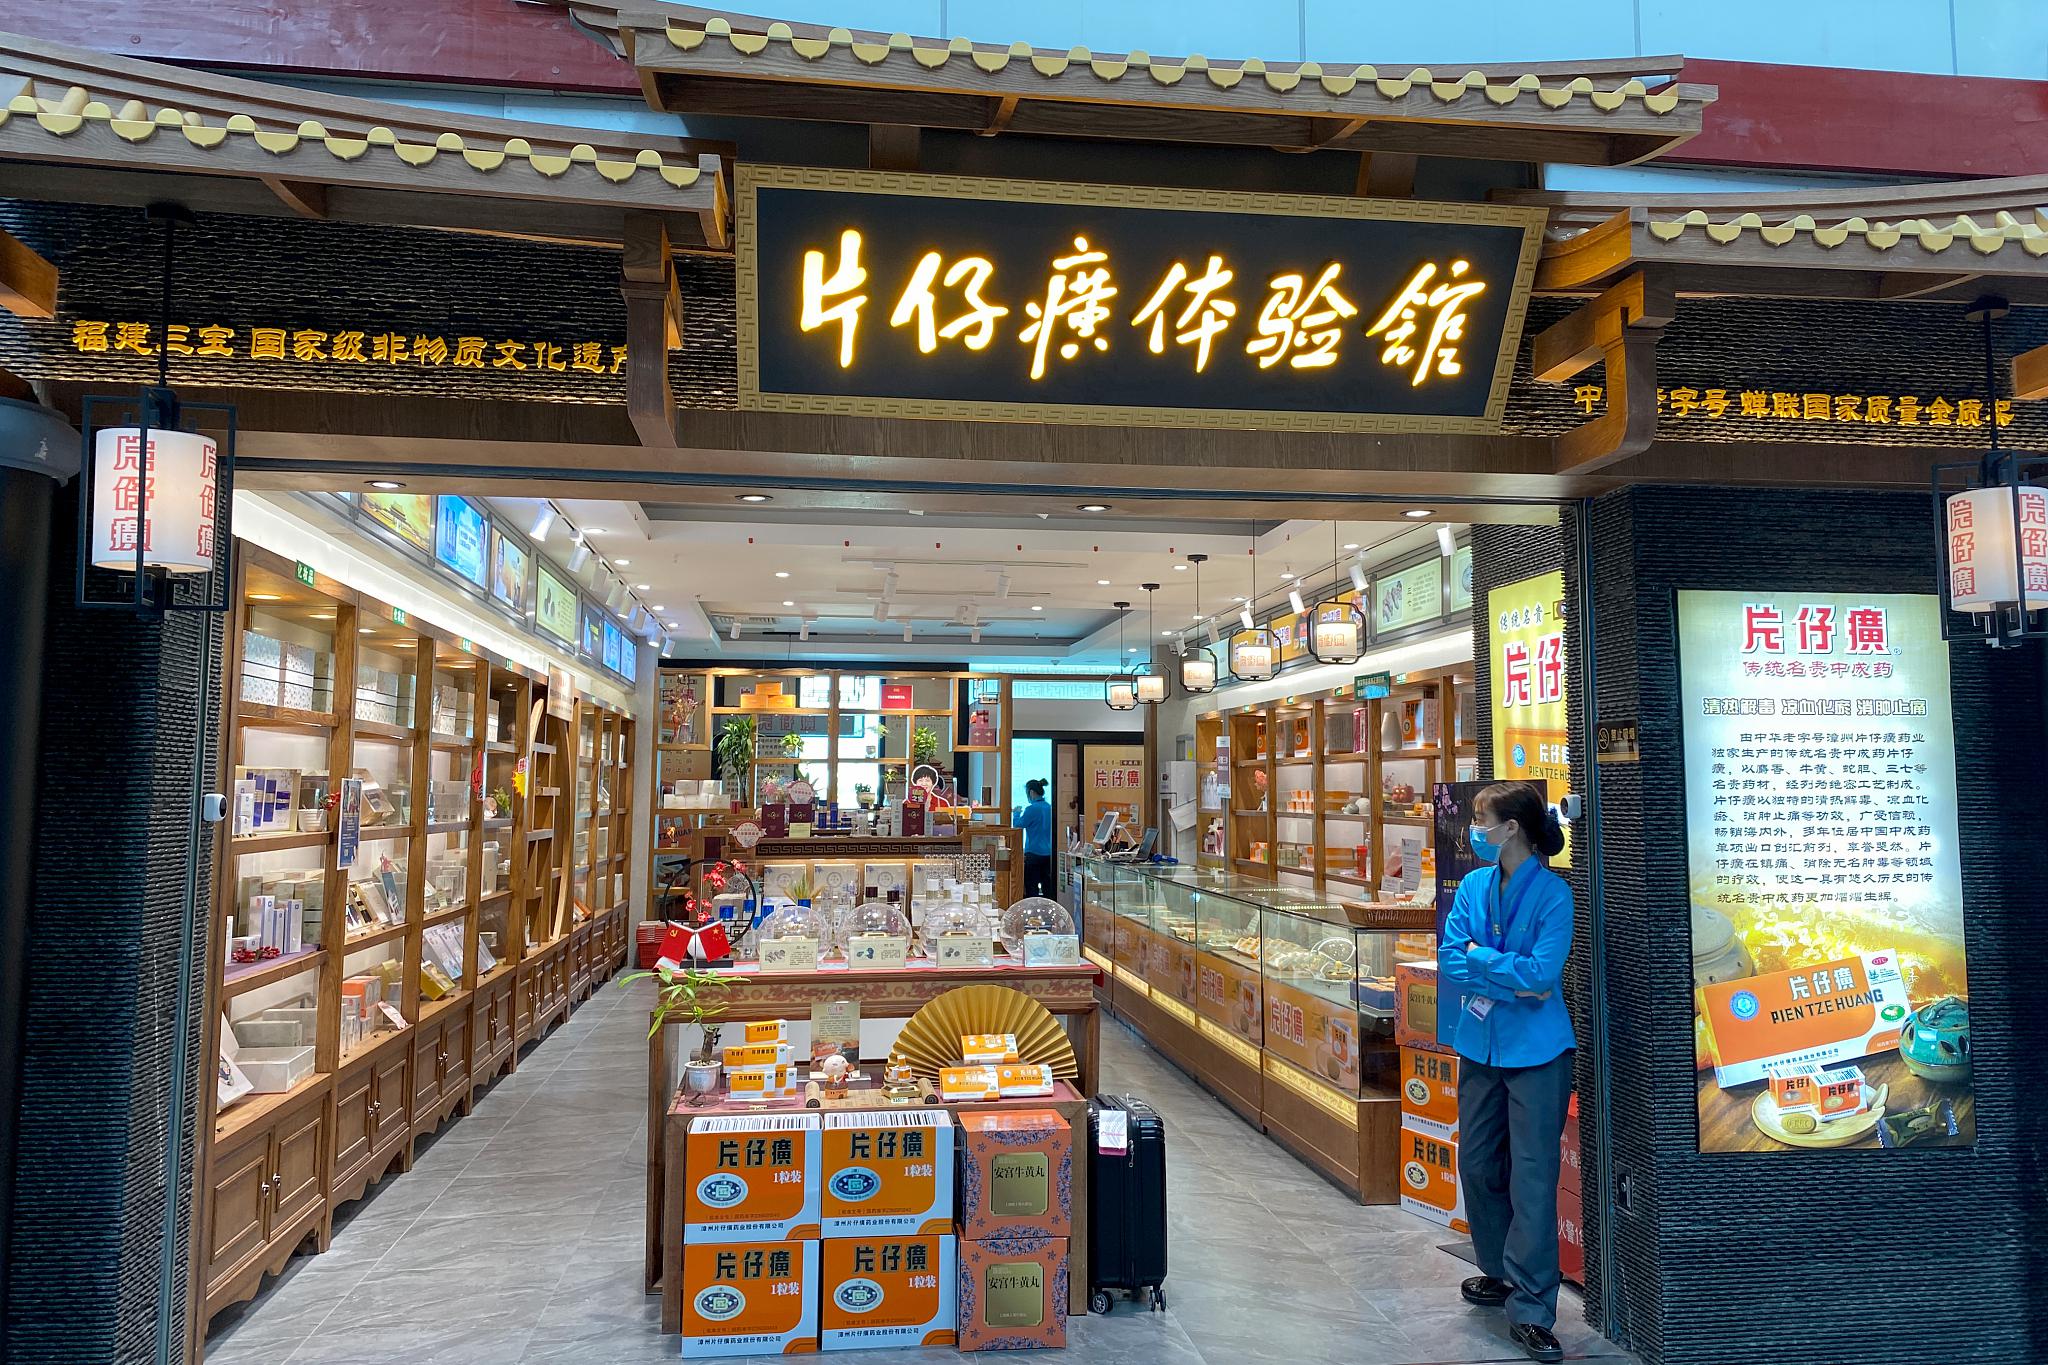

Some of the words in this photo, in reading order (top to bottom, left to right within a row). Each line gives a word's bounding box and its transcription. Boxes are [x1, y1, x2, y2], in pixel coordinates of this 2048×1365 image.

[73, 319, 235, 358] 福建三宝
[250, 326, 628, 374] 国家级非物质文化遗产
[1740, 604, 1890, 654] 片仔癀
[1742, 660, 1893, 679] 传统名贵中成药
[1702, 697, 1776, 716] 清热解毒
[1855, 698, 1928, 717] 消肿止痛
[1788, 966, 1857, 1001] 片仔癀
[1770, 1003, 1805, 1024] PIEN
[1804, 999, 1834, 1019] TZE
[1836, 989, 1885, 1011] HUANG
[1786, 1078, 1810, 1090] 片仔
[718, 1137, 793, 1168] 片仔癀
[851, 1130, 923, 1159] 片仔癀
[773, 1170, 802, 1185] 1粒装
[903, 1164, 933, 1178] 1粒装
[994, 1165, 1045, 1180] 安宫牛黄丸
[715, 1250, 791, 1279] 片仔癀
[855, 1244, 927, 1273] 片仔癀
[770, 1282, 800, 1296] 1粒装
[908, 1275, 937, 1289] 1粒装
[988, 1275, 1040, 1290] 安宫牛黄丸
